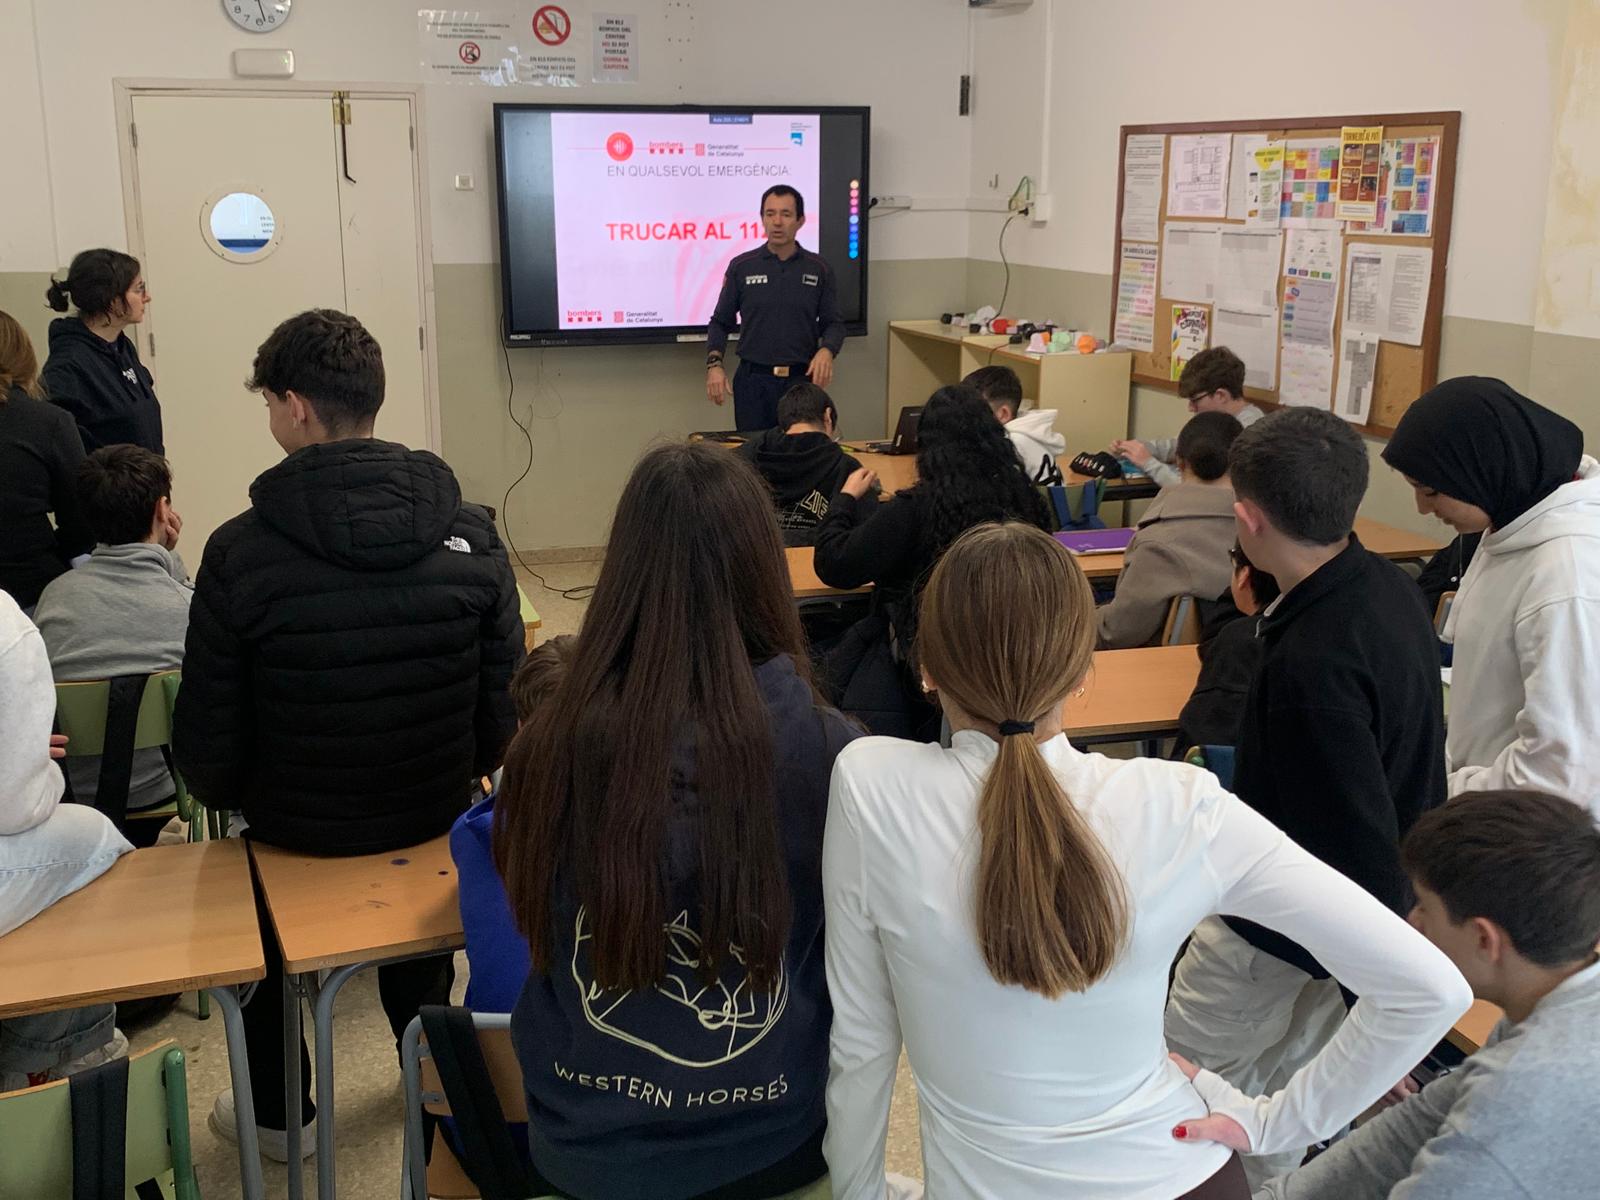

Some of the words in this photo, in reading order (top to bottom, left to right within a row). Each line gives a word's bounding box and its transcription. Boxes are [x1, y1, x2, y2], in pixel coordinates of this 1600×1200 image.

[244, 14, 250, 23] 7
[256, 18, 263, 26] 6
[649, 142, 684, 150] bombers
[607, 165, 626, 177] EN
[628, 165, 705, 177] QUALSEVOL
[606, 222, 698, 240] TRUCAR
[704, 222, 731, 239] AL
[554, 1061, 673, 1109] WESTERN
[686, 1073, 788, 1108] HORSES
